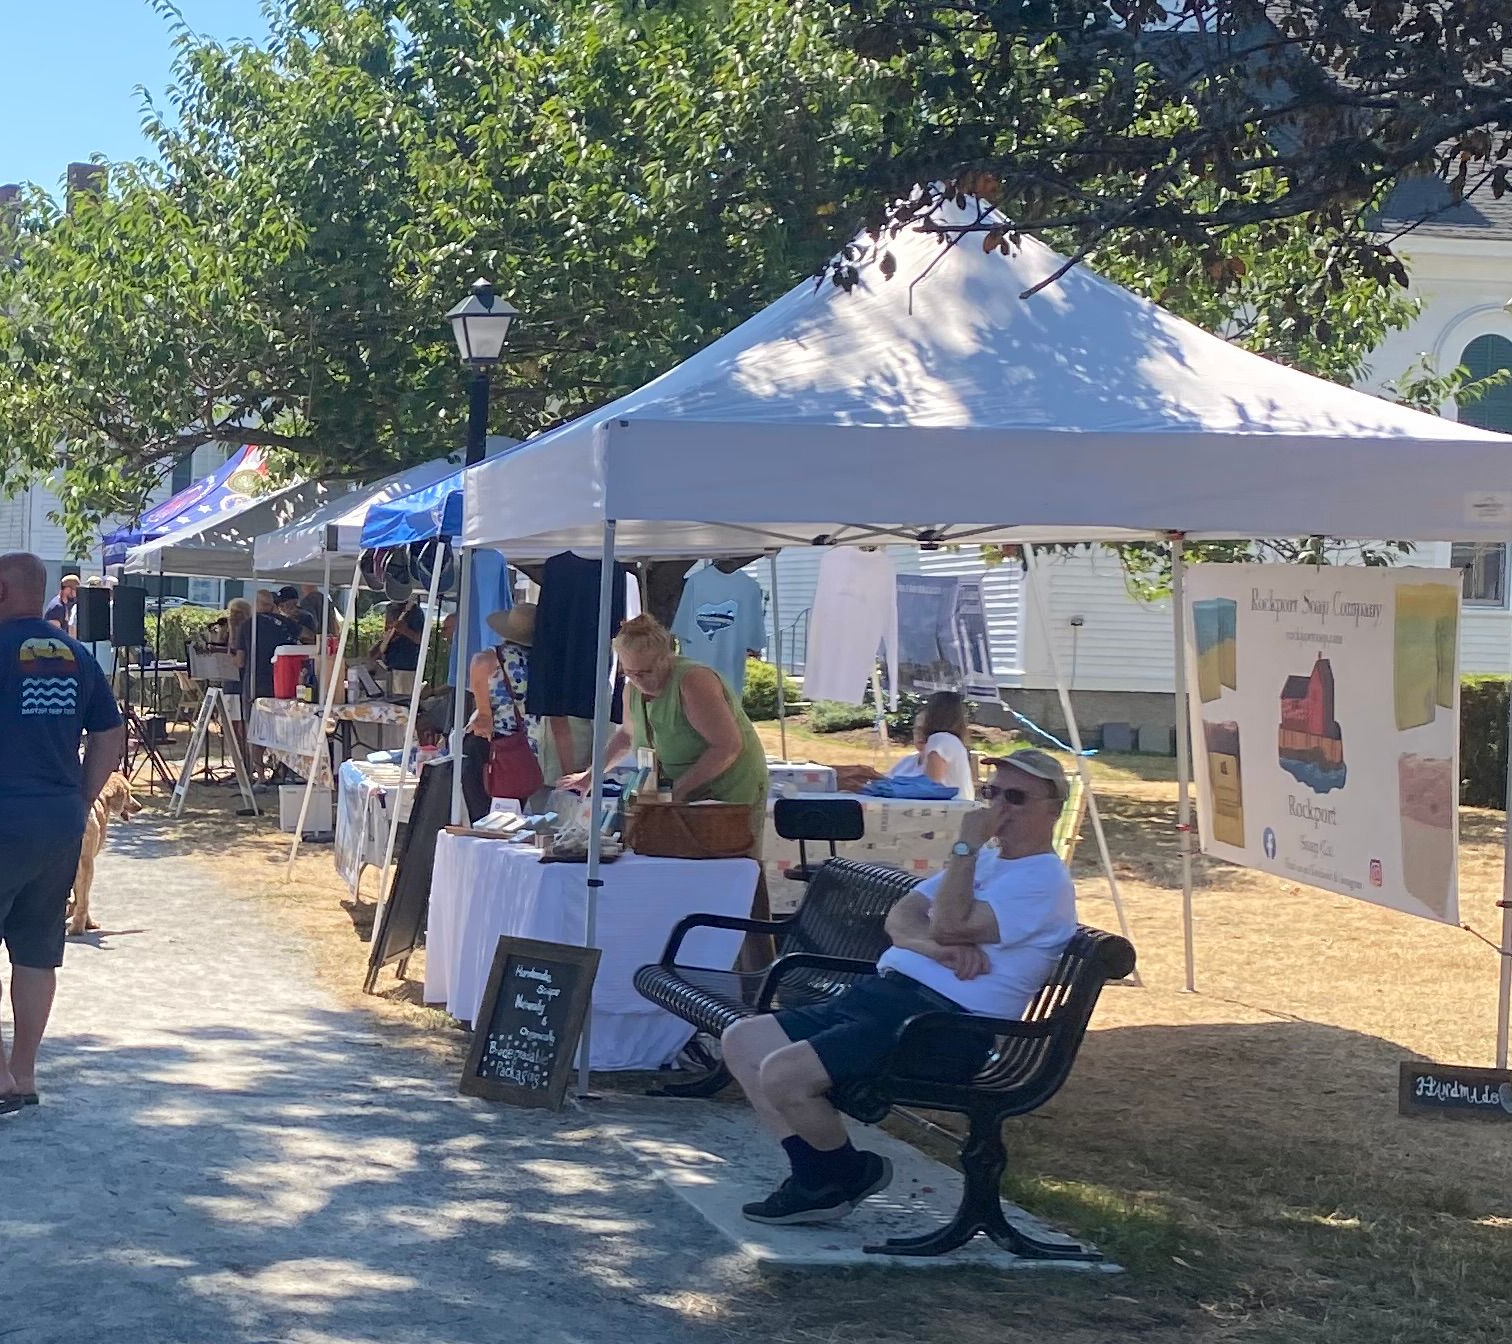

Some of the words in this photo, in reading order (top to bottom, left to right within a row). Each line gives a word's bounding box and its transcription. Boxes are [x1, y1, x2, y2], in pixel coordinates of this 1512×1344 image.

[1252, 588, 1297, 622] Rockport
[1302, 590, 1328, 624] Soap
[1334, 591, 1383, 628] Company
[1289, 795, 1336, 829] Rockport
[496, 1061, 539, 1090] Packaging
